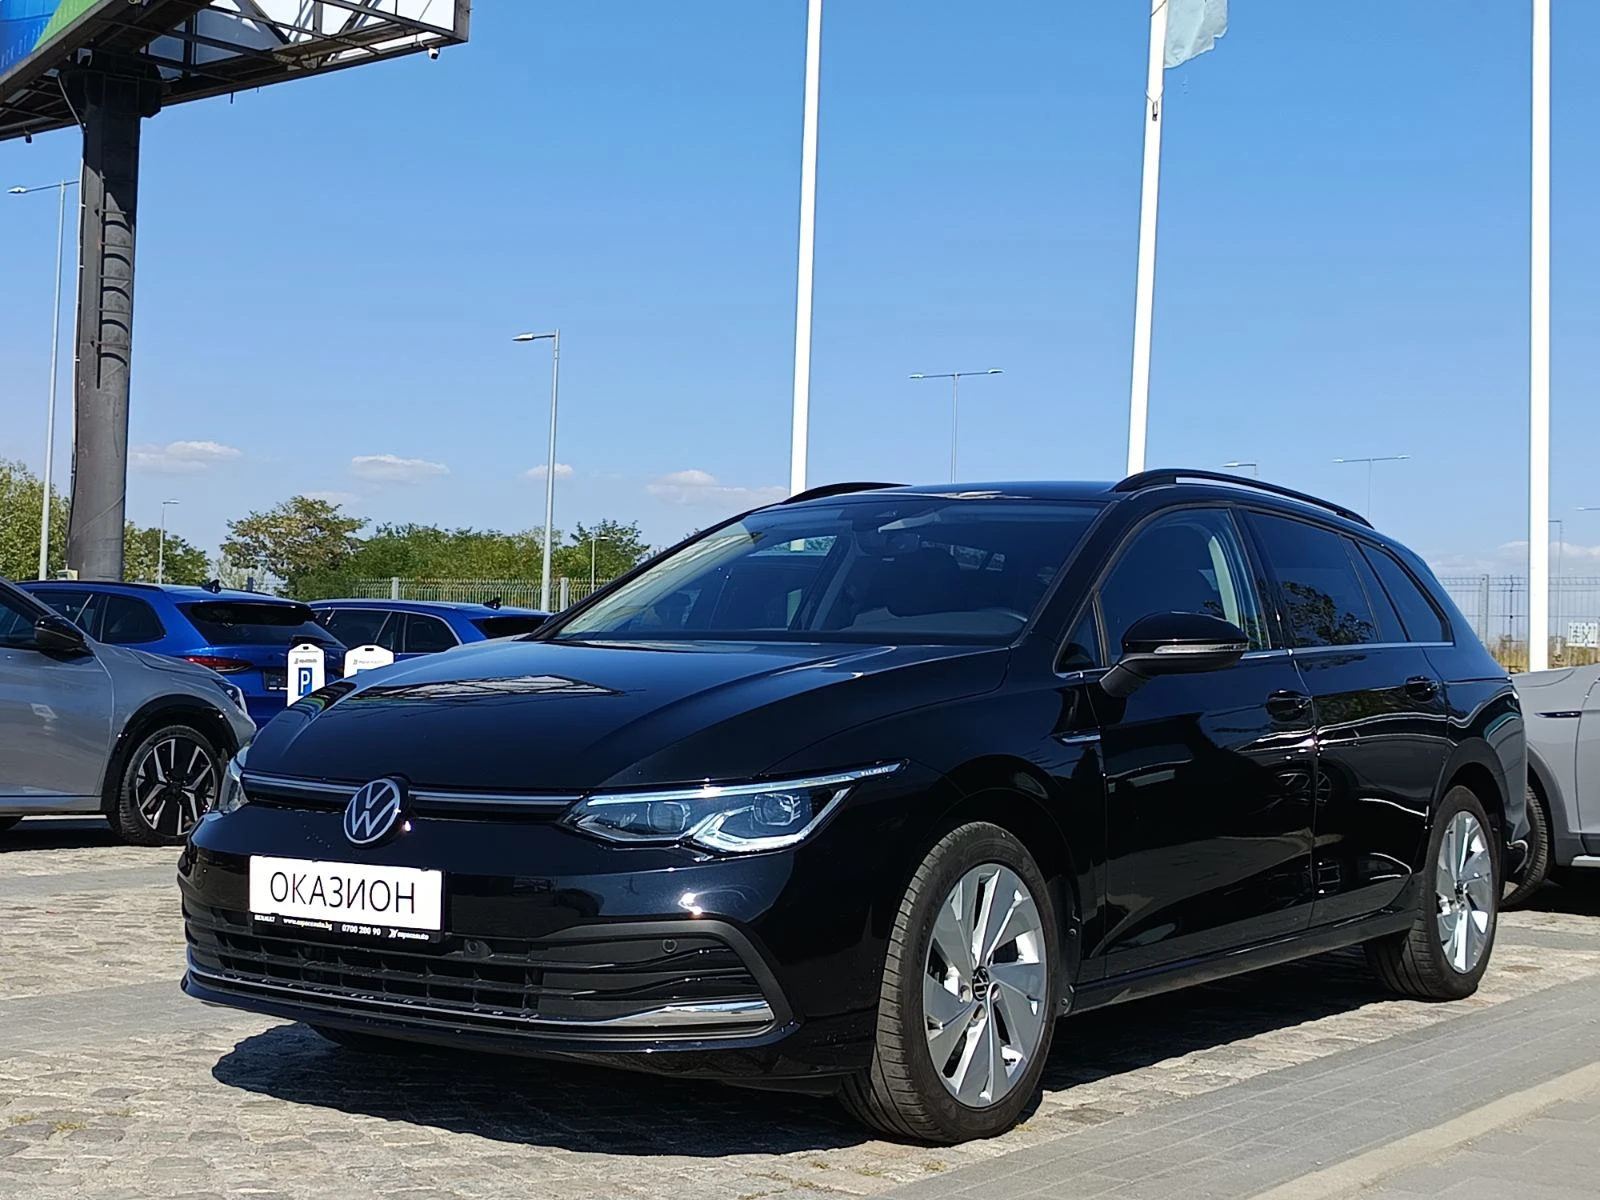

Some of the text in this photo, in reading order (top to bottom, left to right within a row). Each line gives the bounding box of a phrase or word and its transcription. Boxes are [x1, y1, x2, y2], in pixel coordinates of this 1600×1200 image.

[300, 670, 310, 694] P
[270, 871, 415, 914] ОКАЗИОН
[341, 924, 358, 934] 0700
[372, 928, 381, 936] 90
